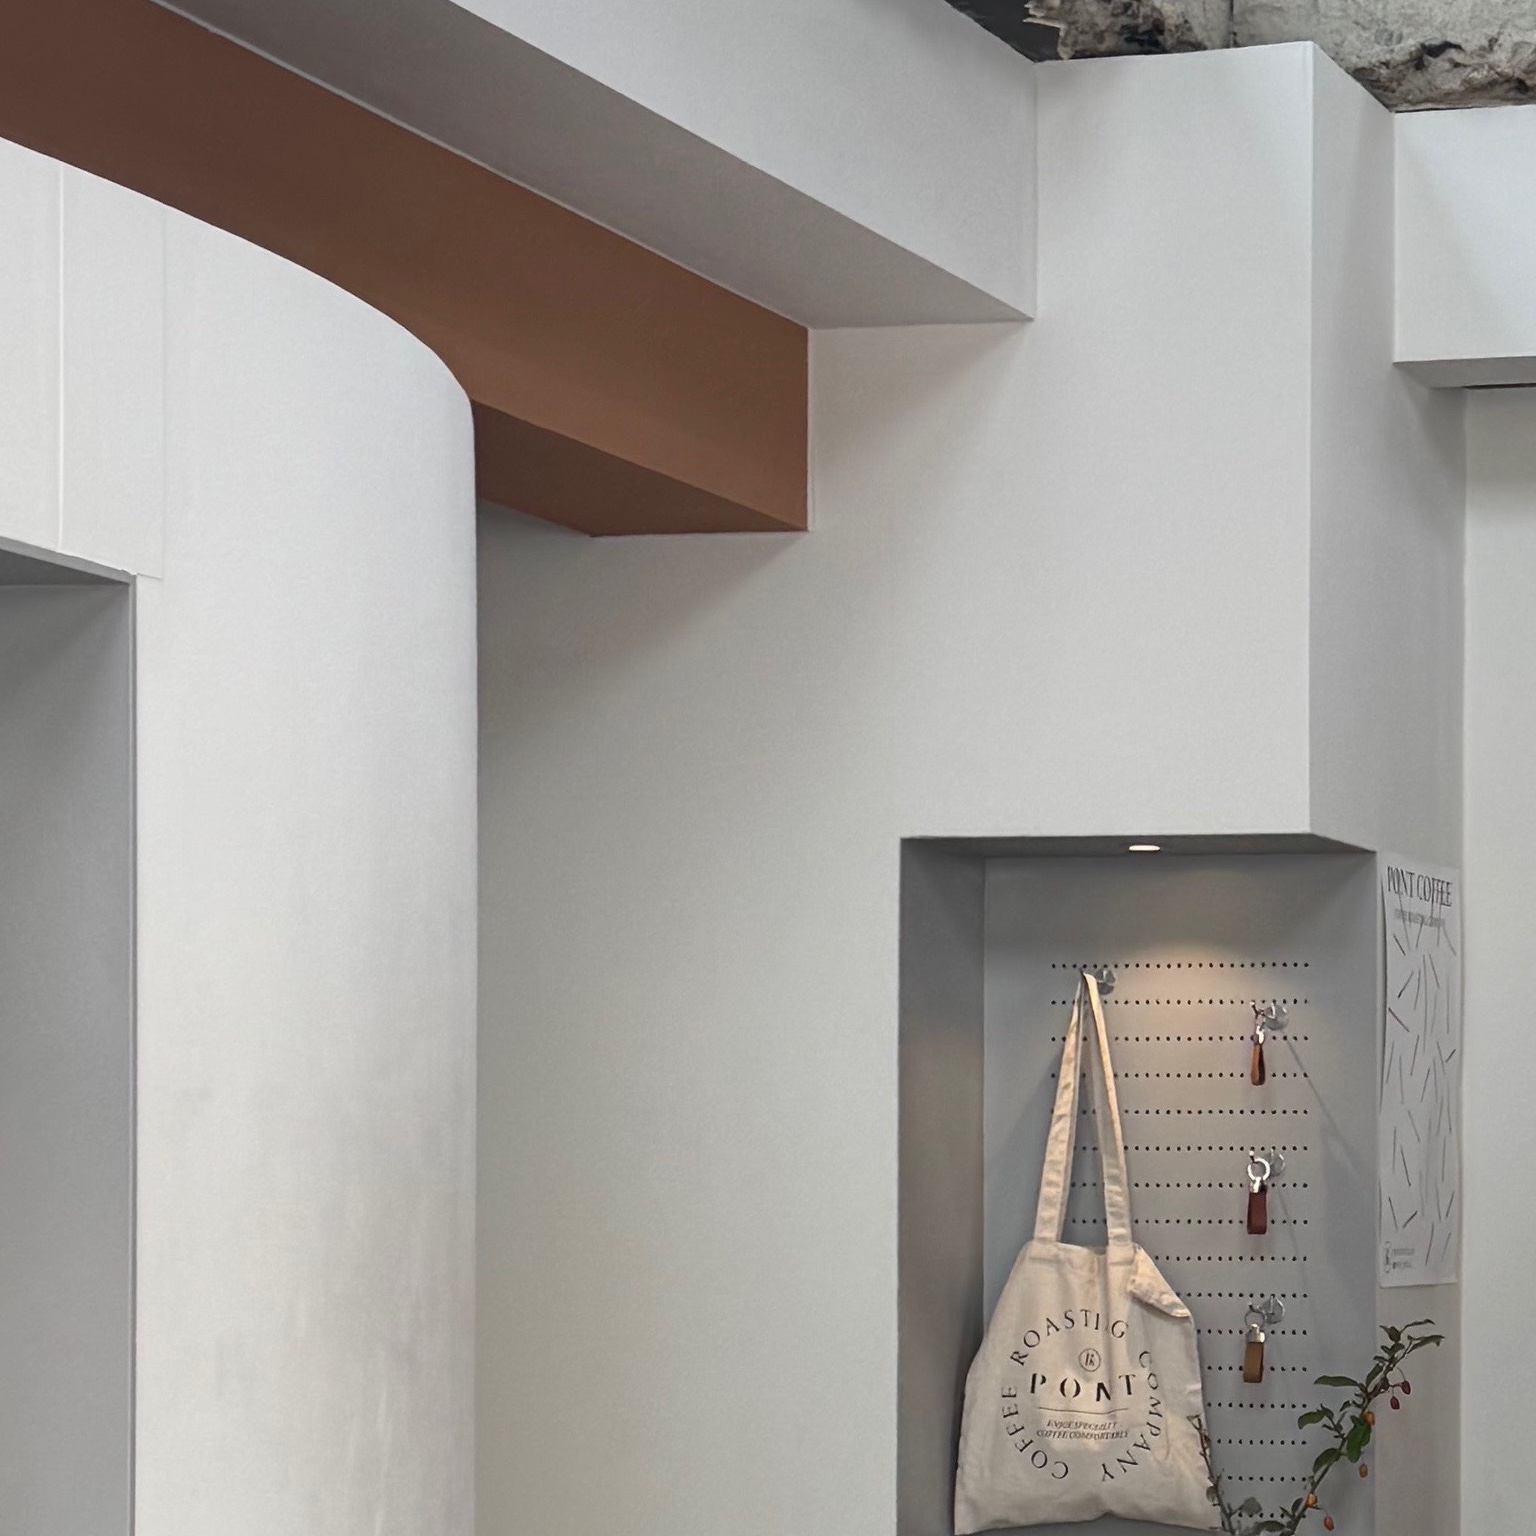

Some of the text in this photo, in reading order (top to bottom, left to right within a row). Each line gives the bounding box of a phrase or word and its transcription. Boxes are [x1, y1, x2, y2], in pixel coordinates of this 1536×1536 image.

[1417, 874, 1453, 907] COFFEE
[1001, 1309, 1164, 1482] COFFEE ROASTIG COMPANY
[1030, 1372, 1136, 1402] PONT
